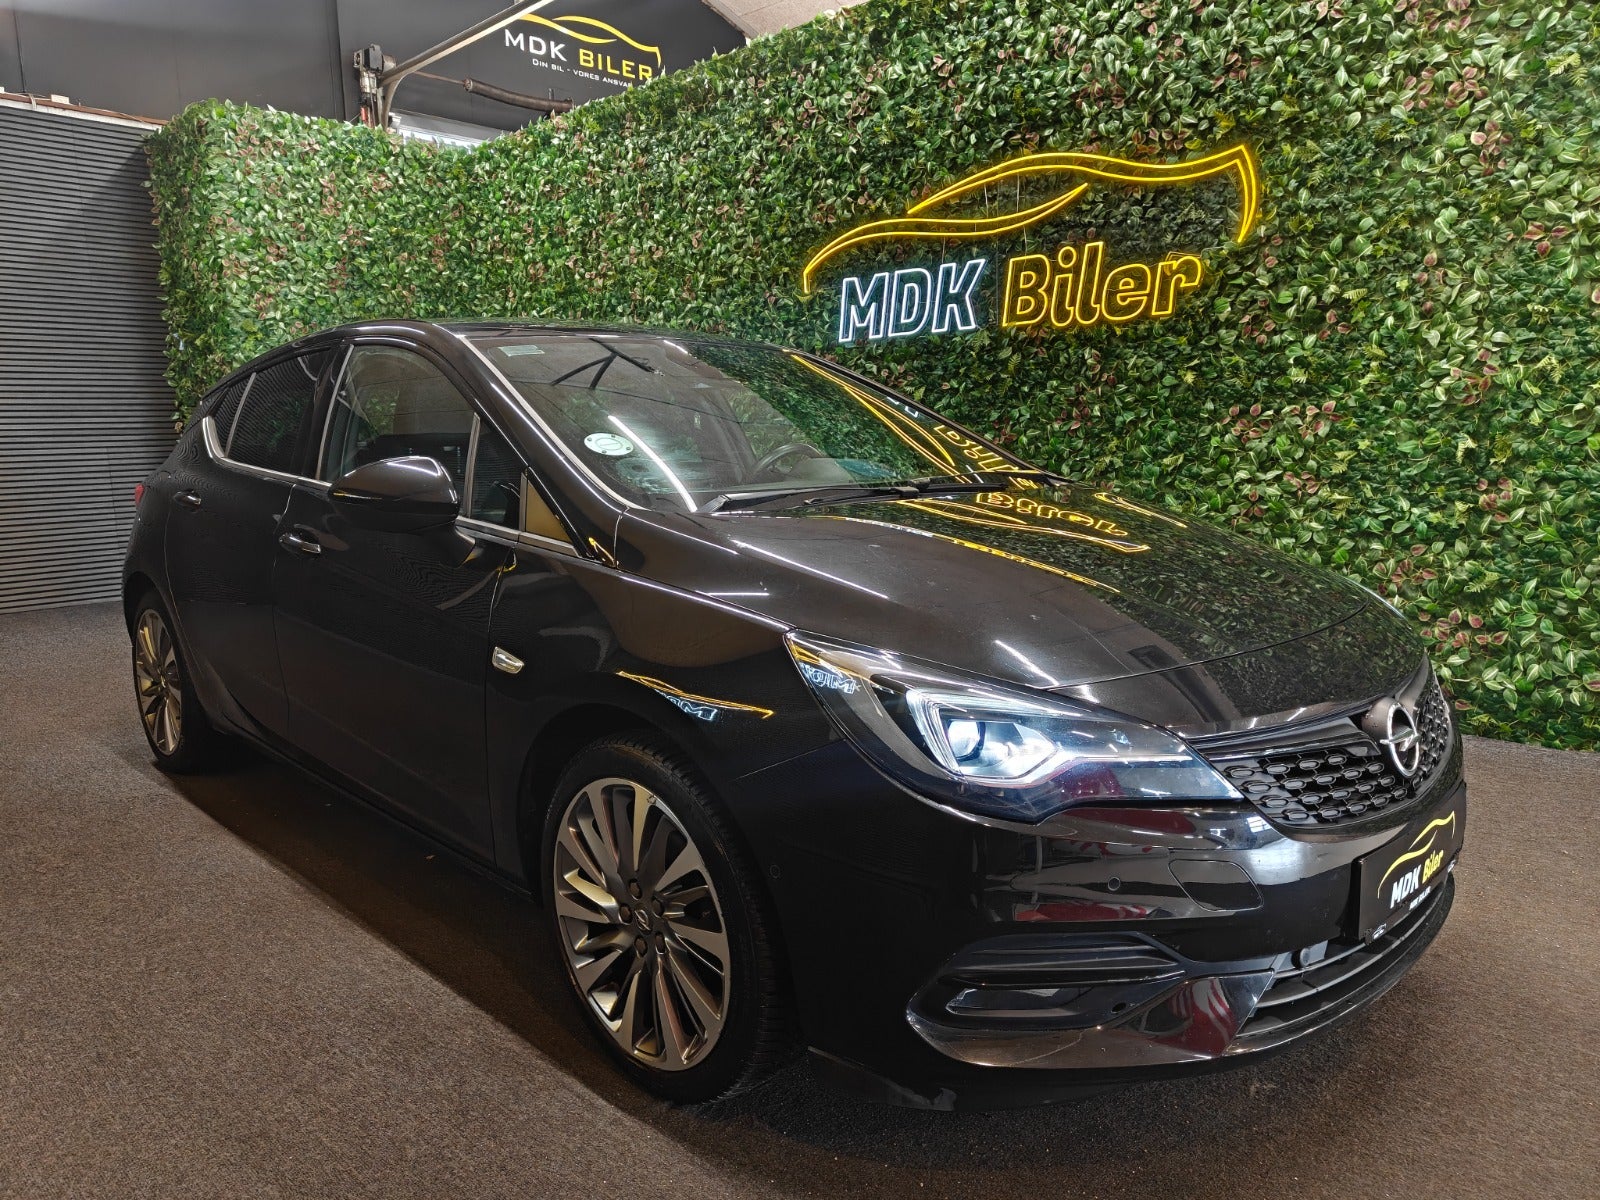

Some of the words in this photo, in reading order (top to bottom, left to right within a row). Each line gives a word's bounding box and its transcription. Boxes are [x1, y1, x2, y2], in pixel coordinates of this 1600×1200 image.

[504, 28, 567, 62] MDK
[579, 48, 653, 81] BILER
[838, 258, 986, 343] MDK
[1002, 241, 1203, 328] Biler
[1390, 864, 1422, 909] MDK
[1422, 849, 1444, 885] Biler
